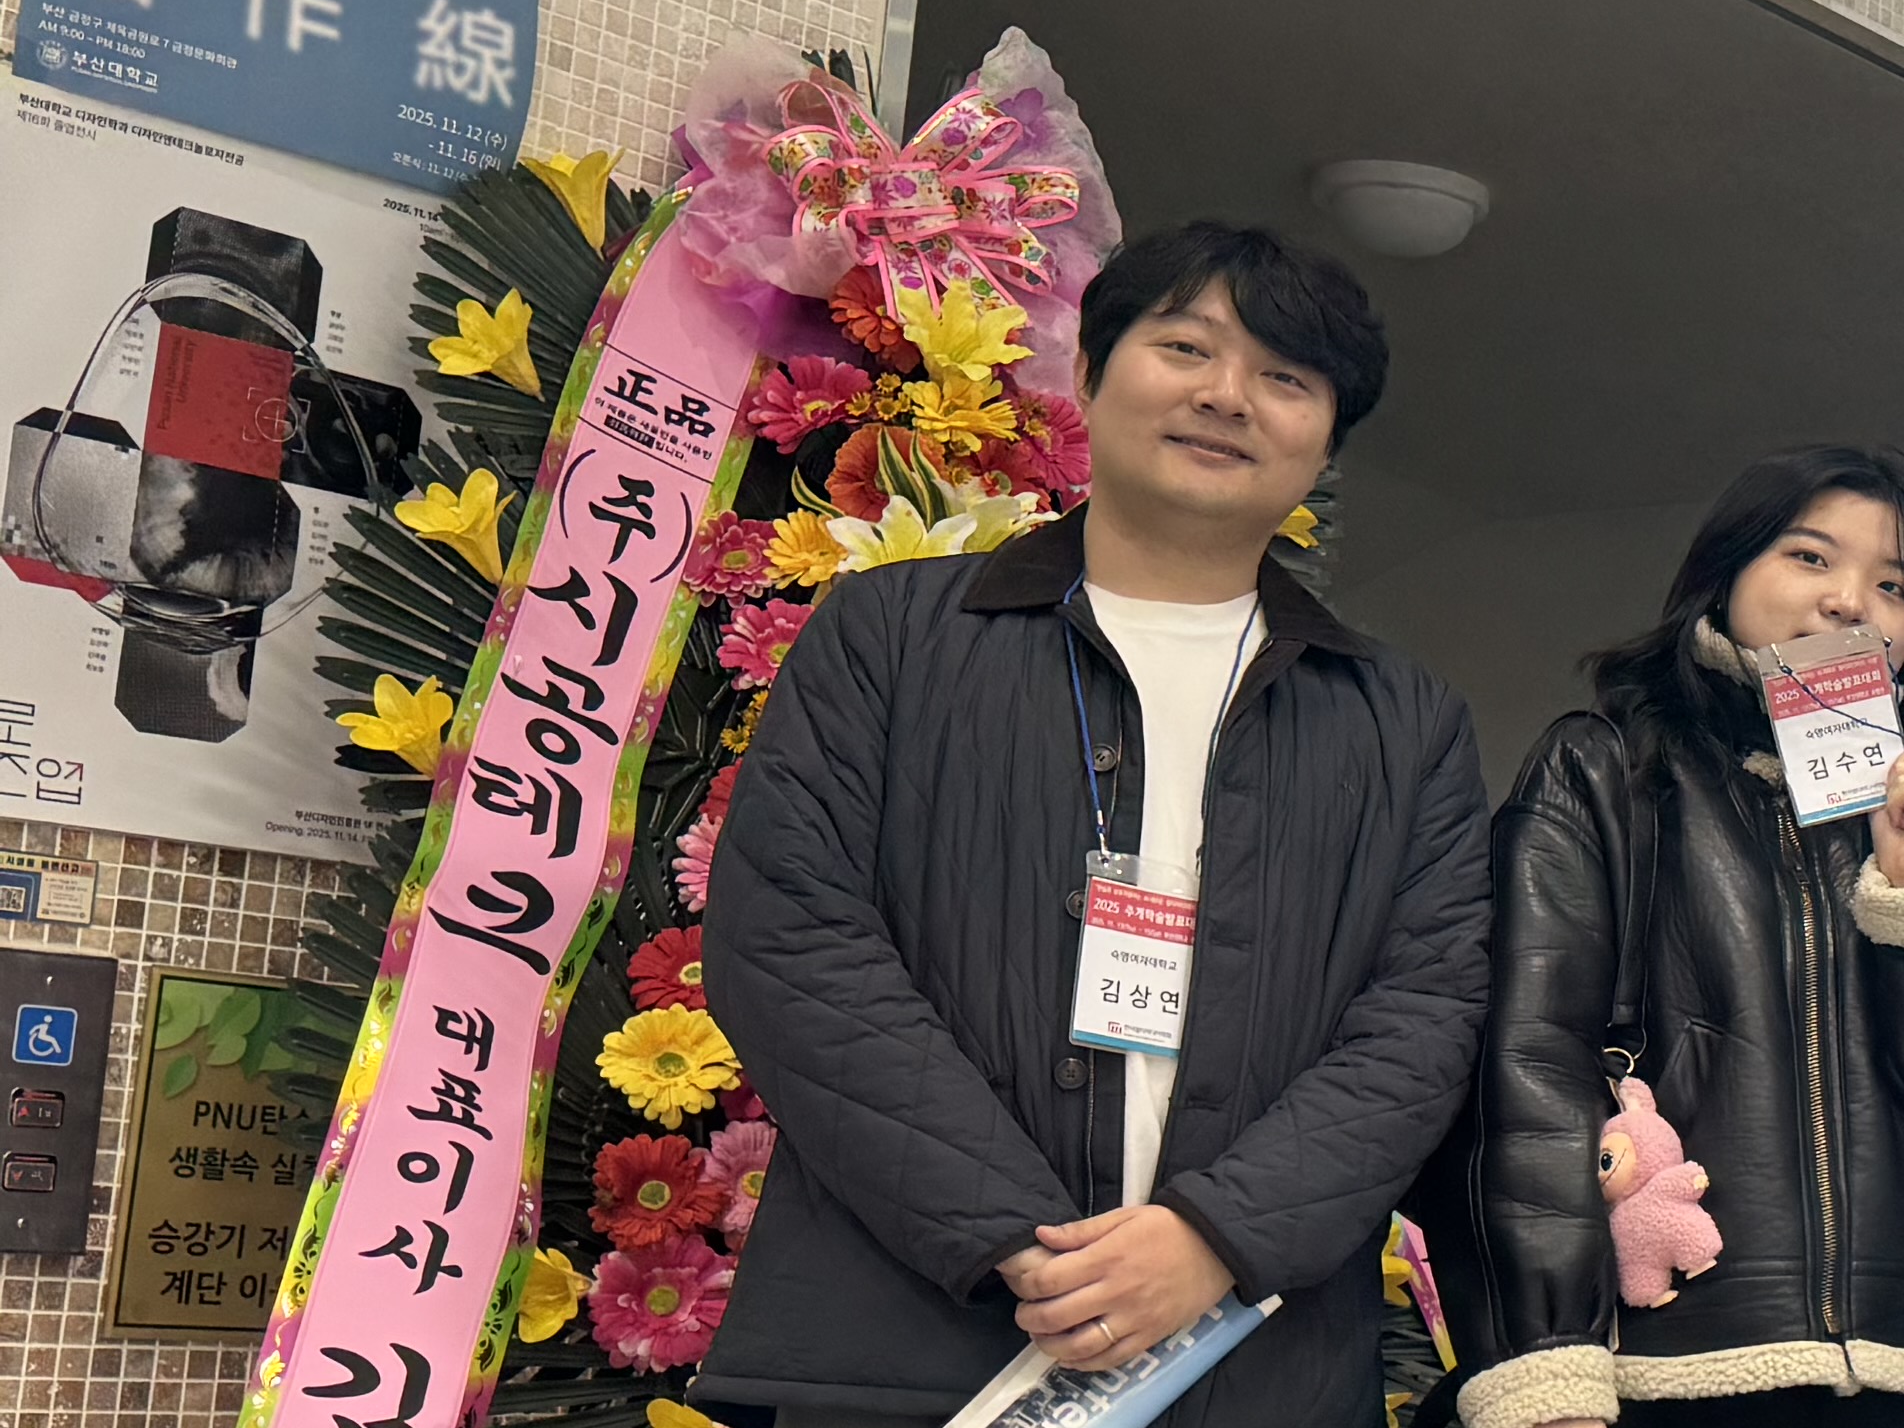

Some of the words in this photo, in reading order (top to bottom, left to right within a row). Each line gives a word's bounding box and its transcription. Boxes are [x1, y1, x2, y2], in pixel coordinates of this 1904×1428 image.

[38, 20, 58, 34] AM
[72, 50, 159, 87] 부산대학교
[19, 92, 72, 118] 부산대학교
[397, 104, 437, 129] 2025.
[442, 117, 462, 135] 11.
[603, 368, 716, 438] 正品
[1775, 689, 1799, 704] 2025
[1806, 670, 1881, 696] 계학술발표대회
[1093, 897, 1120, 914] 2025
[169, 1147, 259, 1183] 생활속
[359, 1005, 495, 1295] 대표이사
[148, 1220, 245, 1259] 승강기
[161, 1270, 227, 1305] 계단
[240, 1272, 278, 1308] 이
